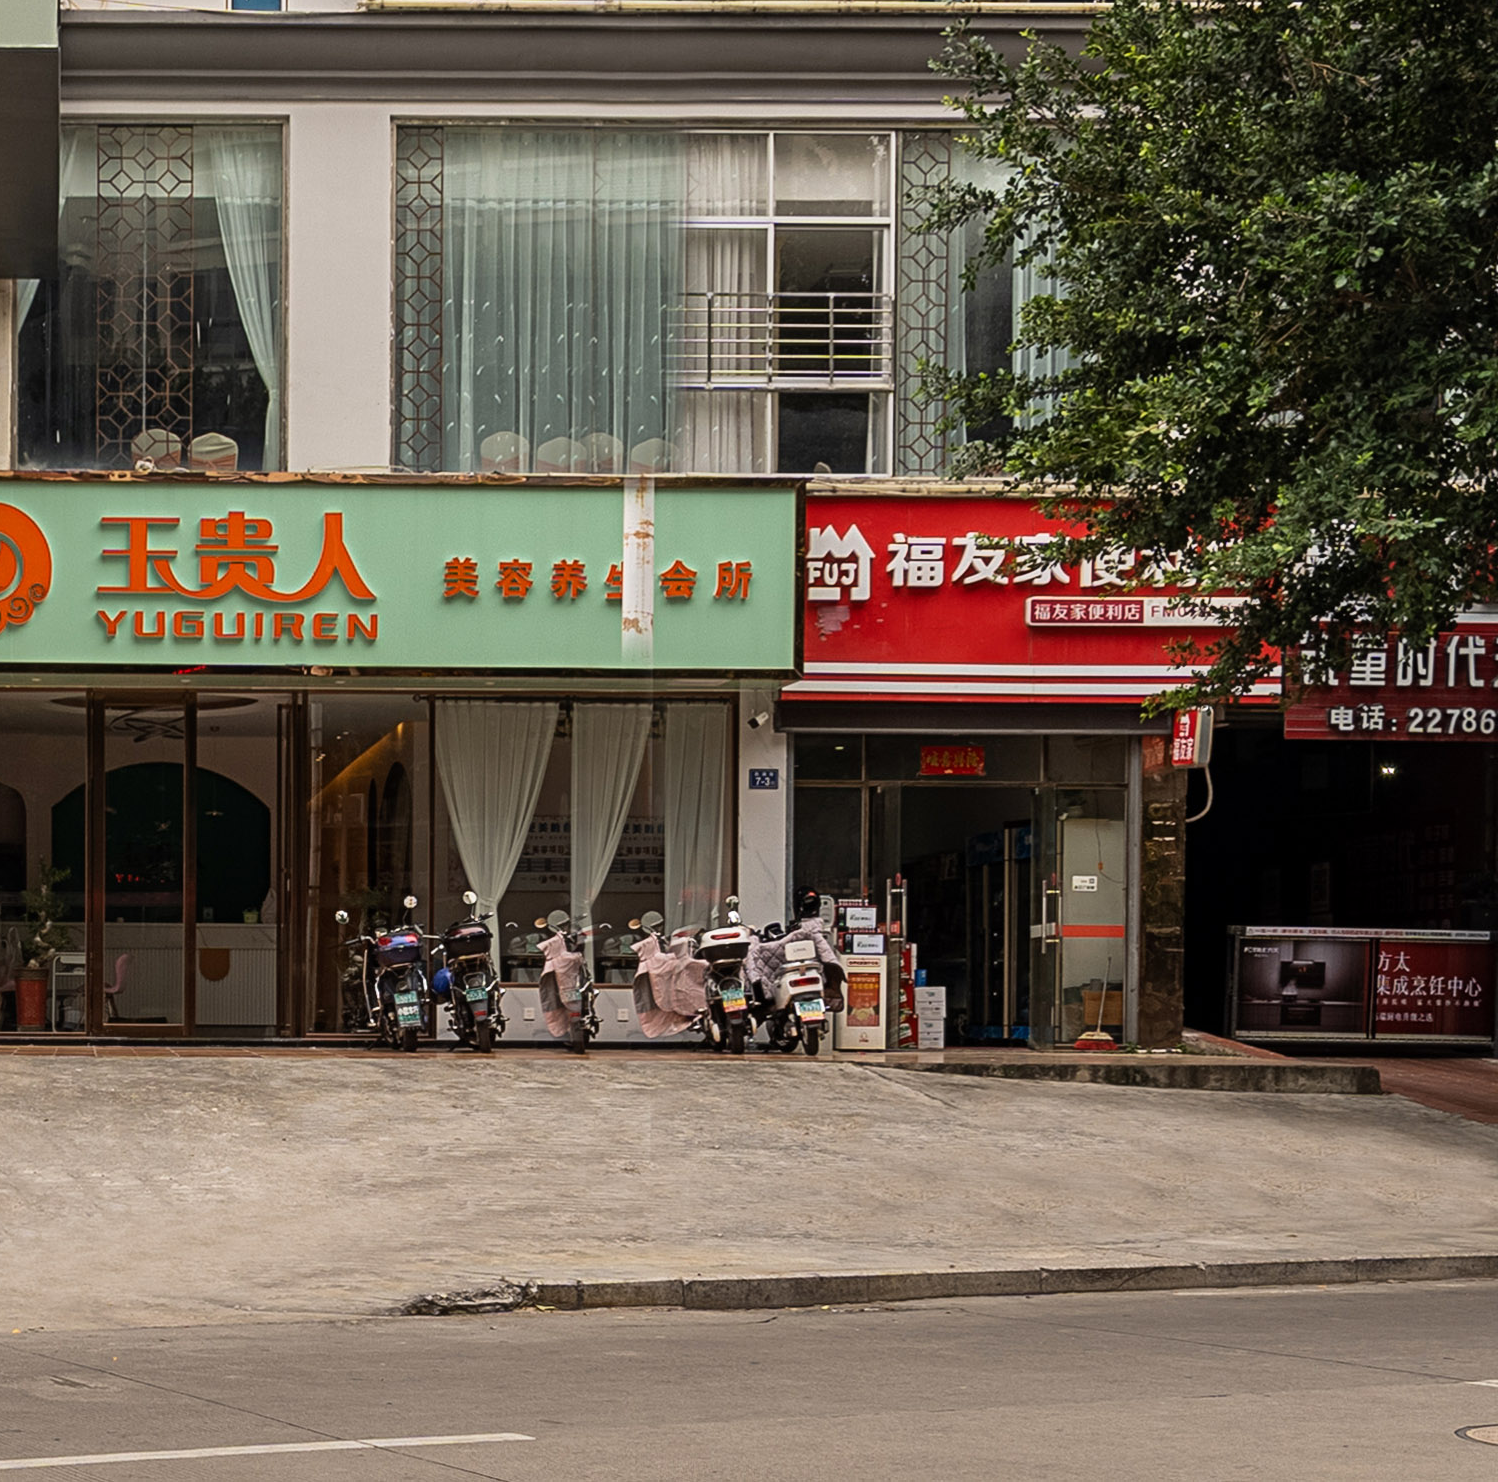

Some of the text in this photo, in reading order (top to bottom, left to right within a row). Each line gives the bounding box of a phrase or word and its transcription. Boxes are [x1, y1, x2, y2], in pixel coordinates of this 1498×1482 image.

[97, 511, 377, 602] 玉贵人
[886, 531, 1250, 589] 福友家便利
[1032, 601, 1141, 623] 福友家便利店
[98, 610, 379, 642] YUGUIREN
[1378, 951, 1411, 972] 方太
[1377, 974, 1482, 997] 集成烹饪中心
